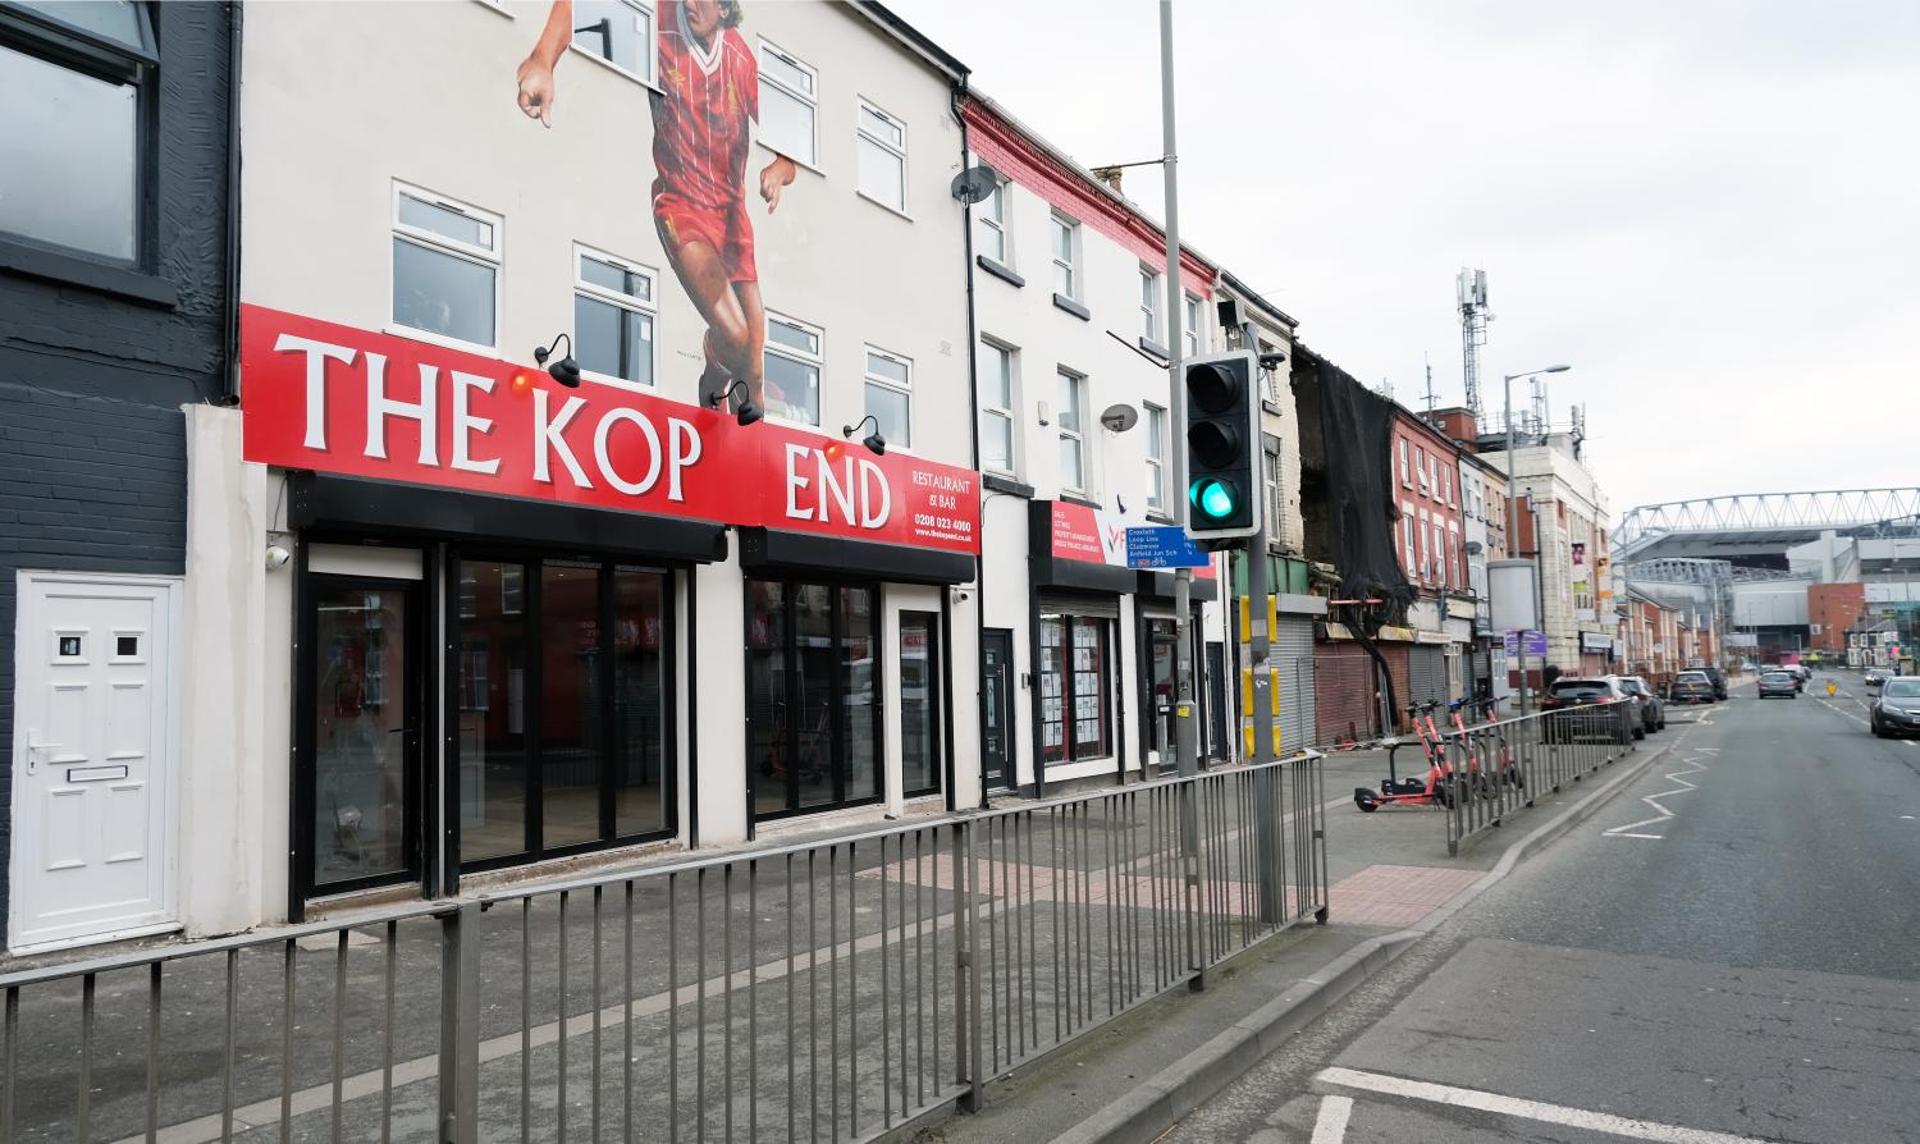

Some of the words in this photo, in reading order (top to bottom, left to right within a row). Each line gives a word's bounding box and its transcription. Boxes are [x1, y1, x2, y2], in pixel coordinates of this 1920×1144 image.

[273, 333, 501, 475] THE
[531, 387, 702, 502] KOP
[785, 442, 891, 529] END
[912, 470, 971, 495] RESTAURANT
[929, 494, 938, 507] &
[939, 494, 957, 510] BAR
[914, 513, 935, 527] 0208
[936, 516, 951, 529] 023
